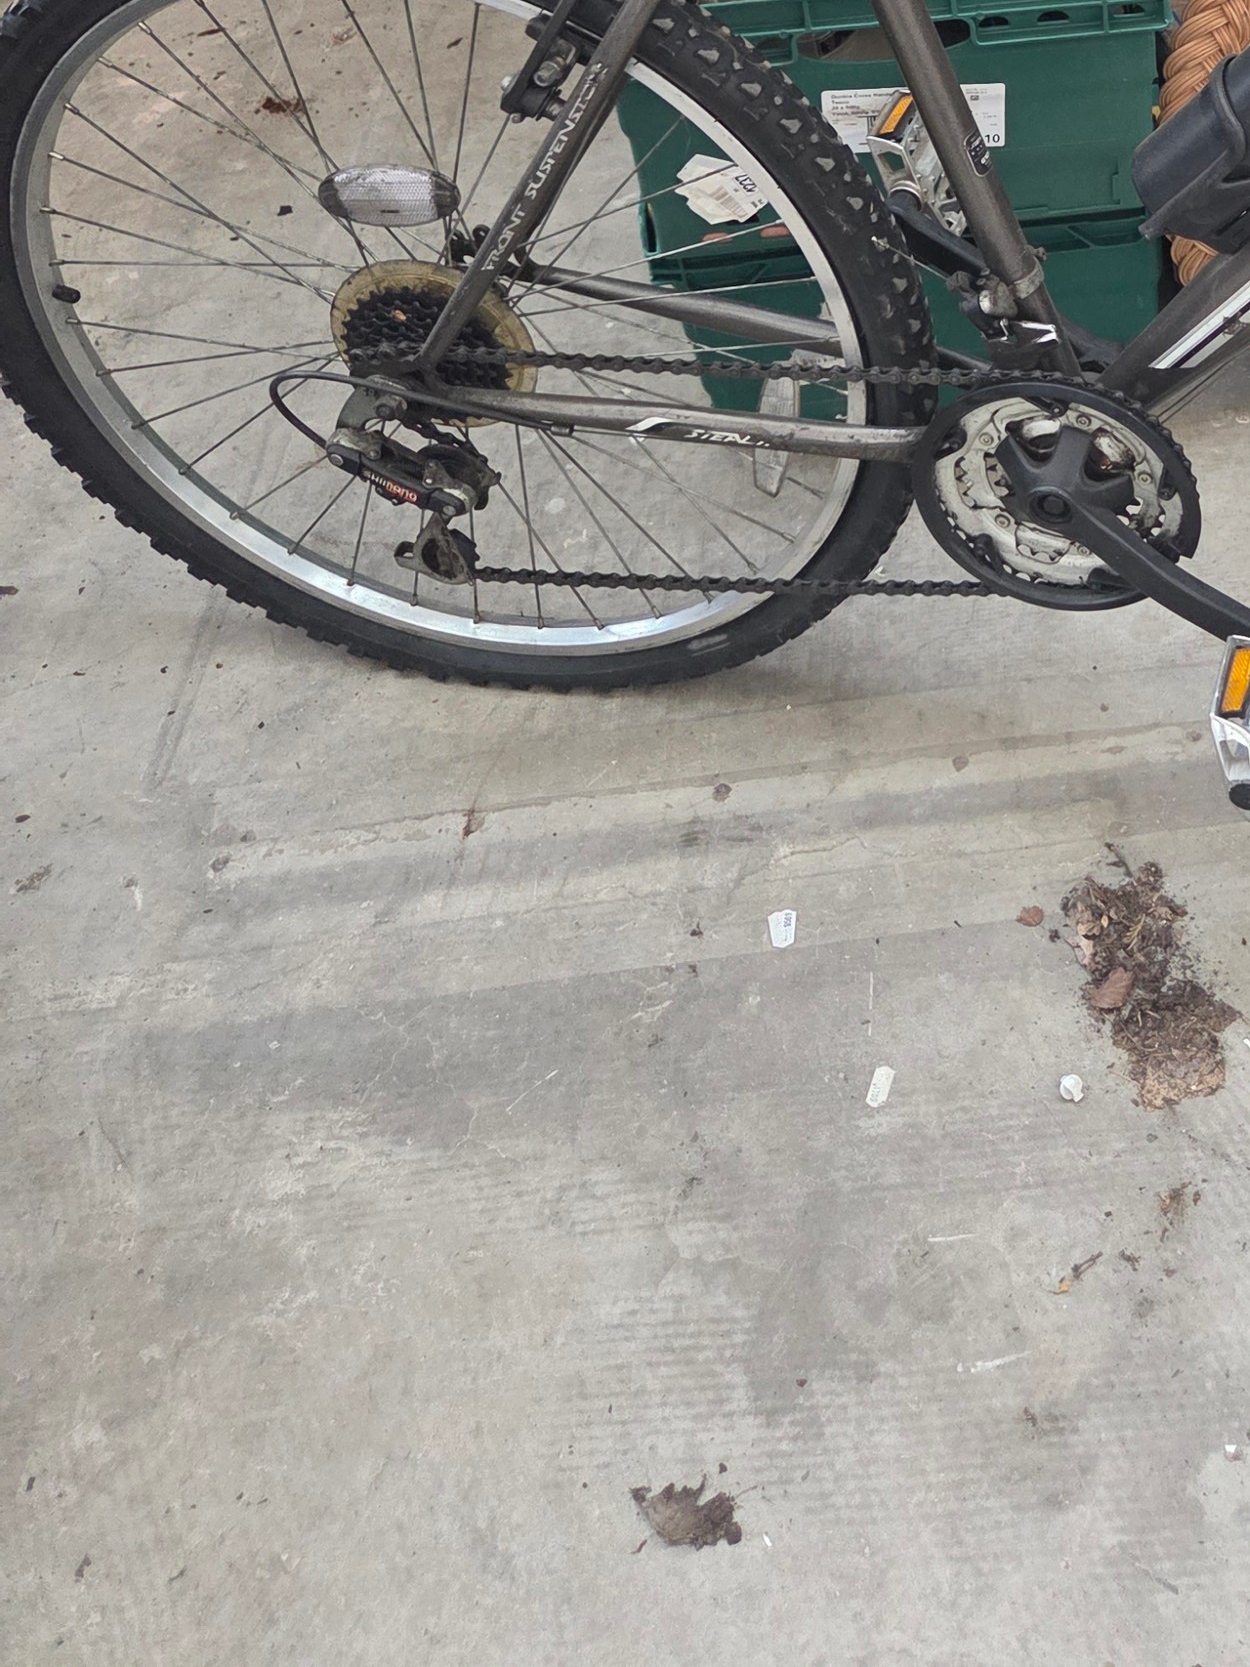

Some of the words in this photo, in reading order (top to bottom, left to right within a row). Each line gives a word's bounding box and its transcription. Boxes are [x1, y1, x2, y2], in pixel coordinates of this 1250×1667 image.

[984, 133, 1001, 144] 10
[481, 202, 526, 272] FRONT
[683, 429, 770, 447] STEAL
